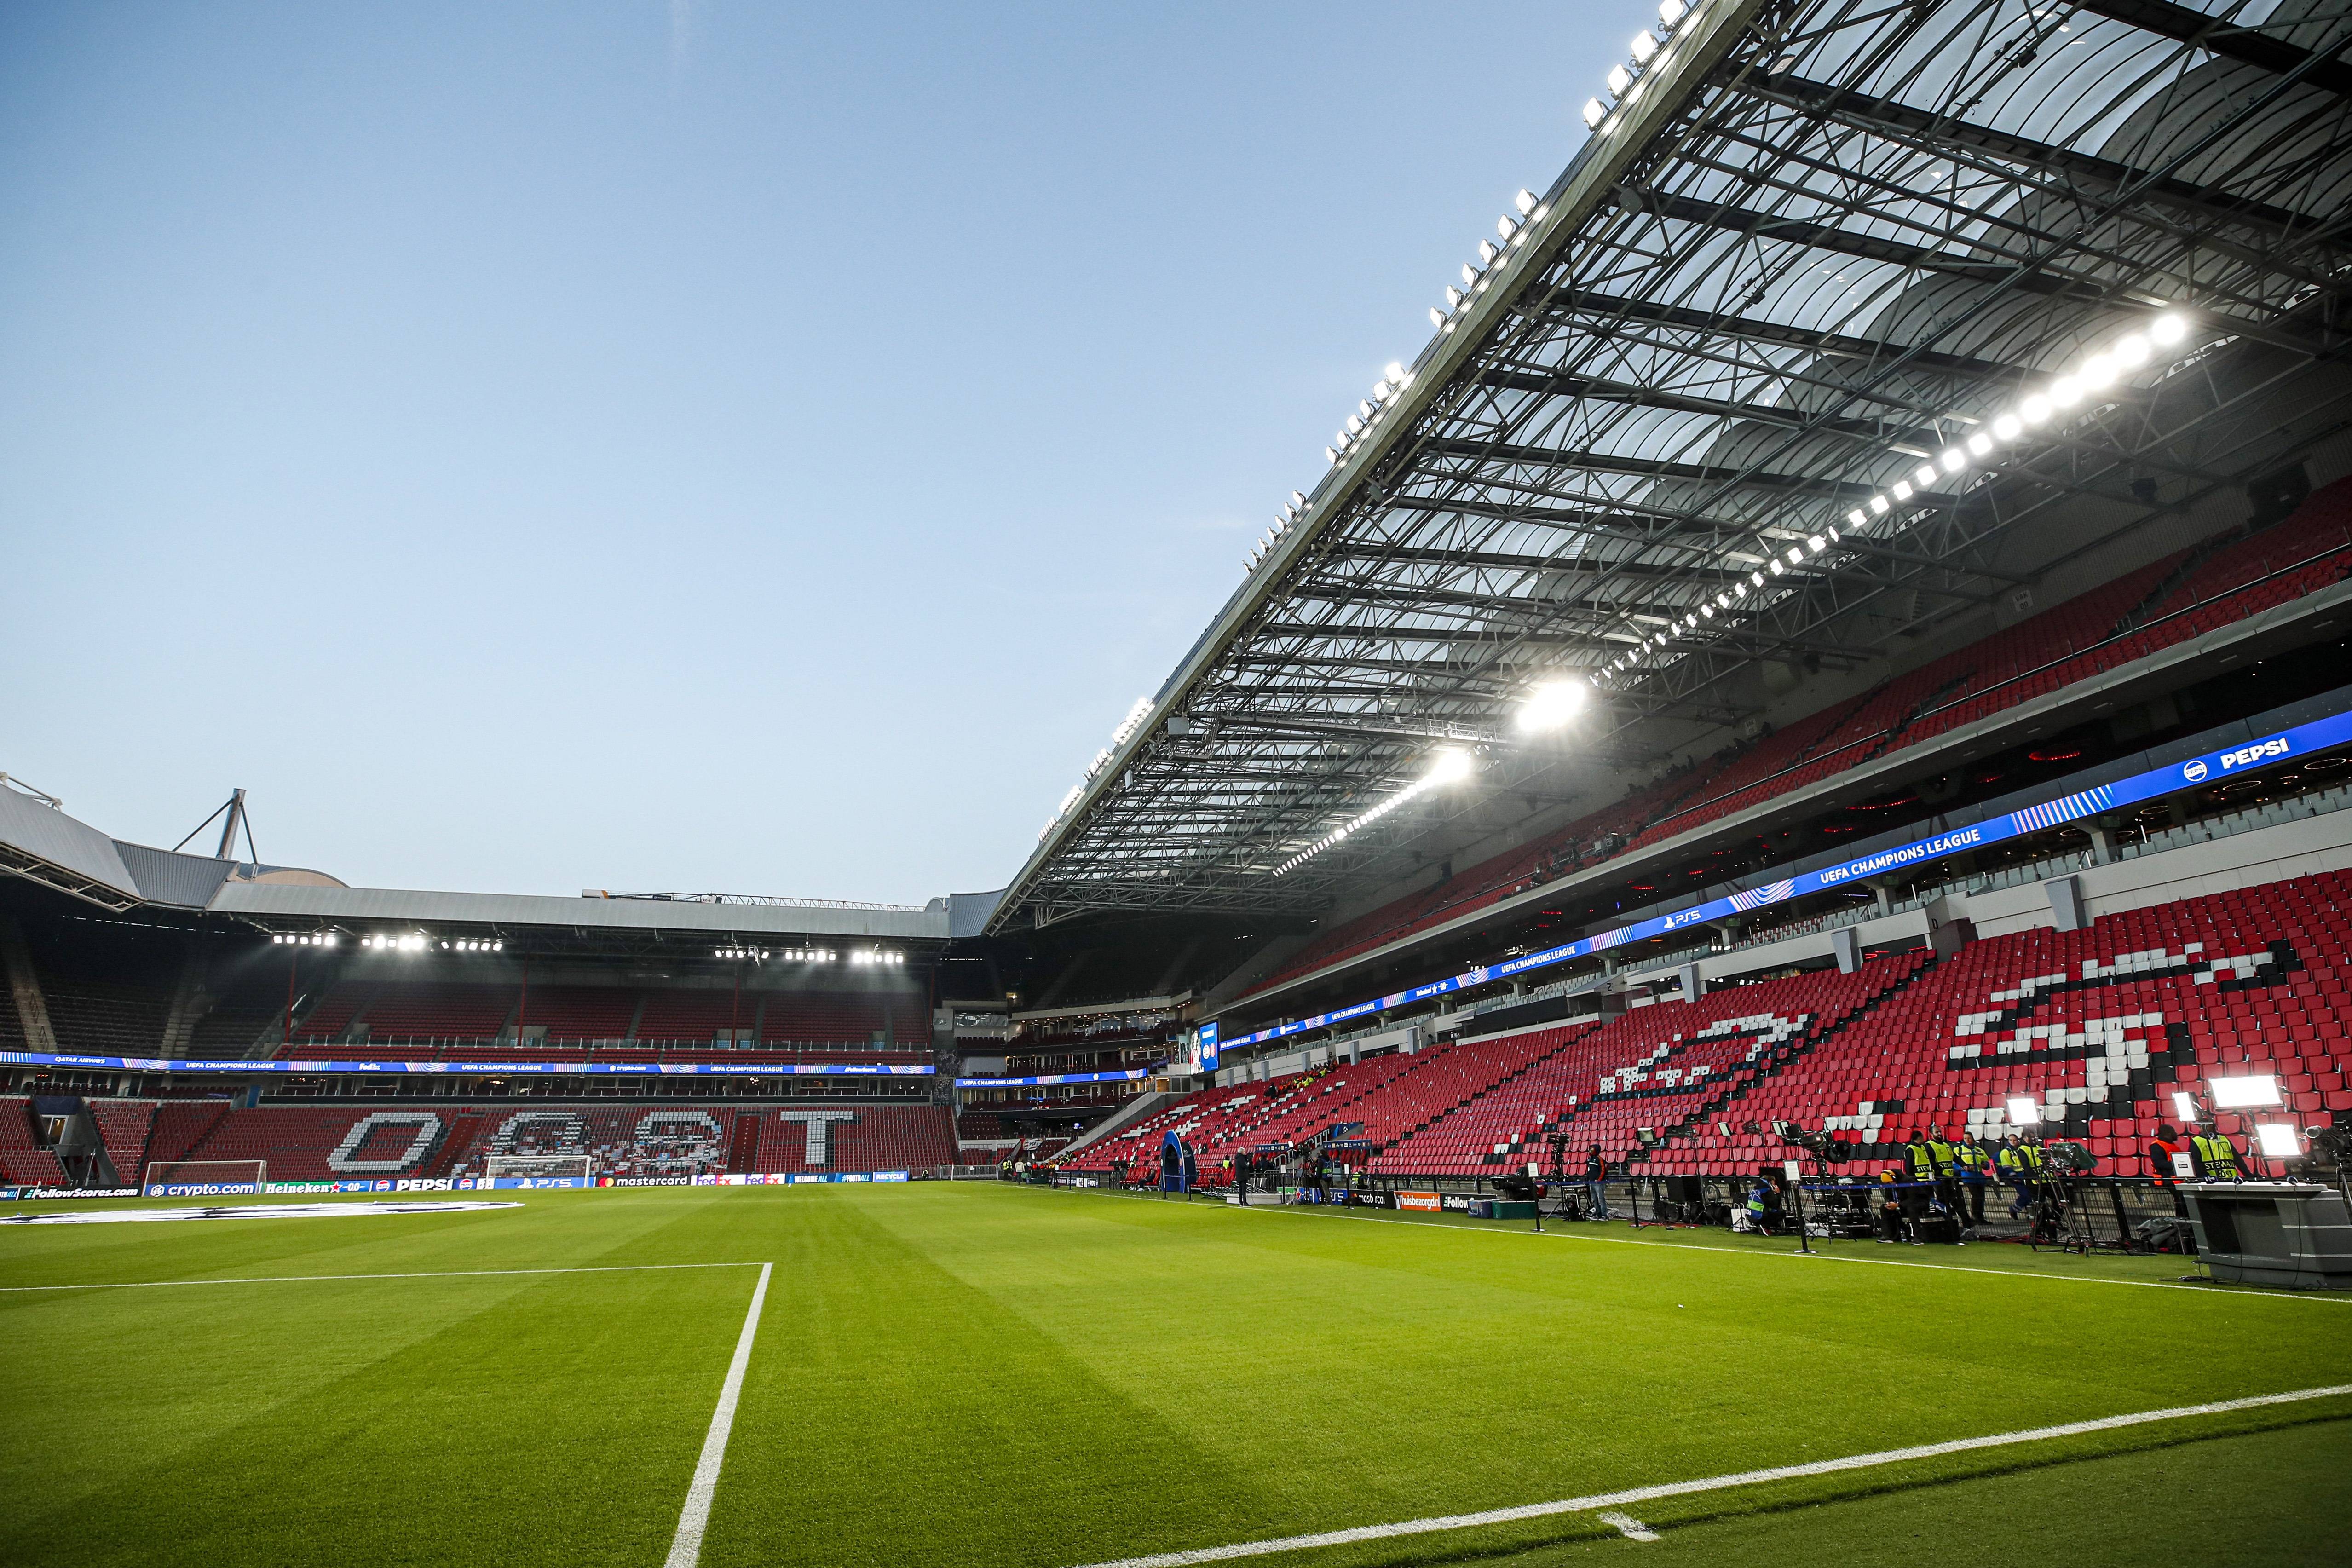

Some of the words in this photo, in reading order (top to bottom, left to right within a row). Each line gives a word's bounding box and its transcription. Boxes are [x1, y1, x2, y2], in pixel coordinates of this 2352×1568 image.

[2220, 737, 2289, 769] PEPSI
[1820, 867, 1850, 883] UEFA
[1851, 845, 1925, 875] CHAMPIONS
[1926, 829, 1980, 854] LEAGUE
[1675, 910, 1701, 924] PS5
[1501, 963, 1516, 973] UEFA
[1516, 953, 1551, 969] CHAMPIONS
[1551, 945, 1576, 960] LEAGUE
[1341, 1007, 1360, 1018] CHAMPIONS
[1361, 1003, 1375, 1012] LEAGUE
[1227, 1038, 1240, 1047] CHAMPIONS
[536, 1179, 572, 1188] PS5
[617, 1176, 687, 1187] mastercard
[697, 1174, 732, 1186] FedEx
[746, 1174, 780, 1185] FedEx
[818, 1174, 828, 1182] ALL
[842, 1174, 870, 1182] #FOOTBALL
[168, 1184, 253, 1196] crypto.com
[265, 1183, 329, 1194] Heineken
[396, 1179, 453, 1192] PEPSI
[34, 1188, 138, 1198] FollowScores.com
